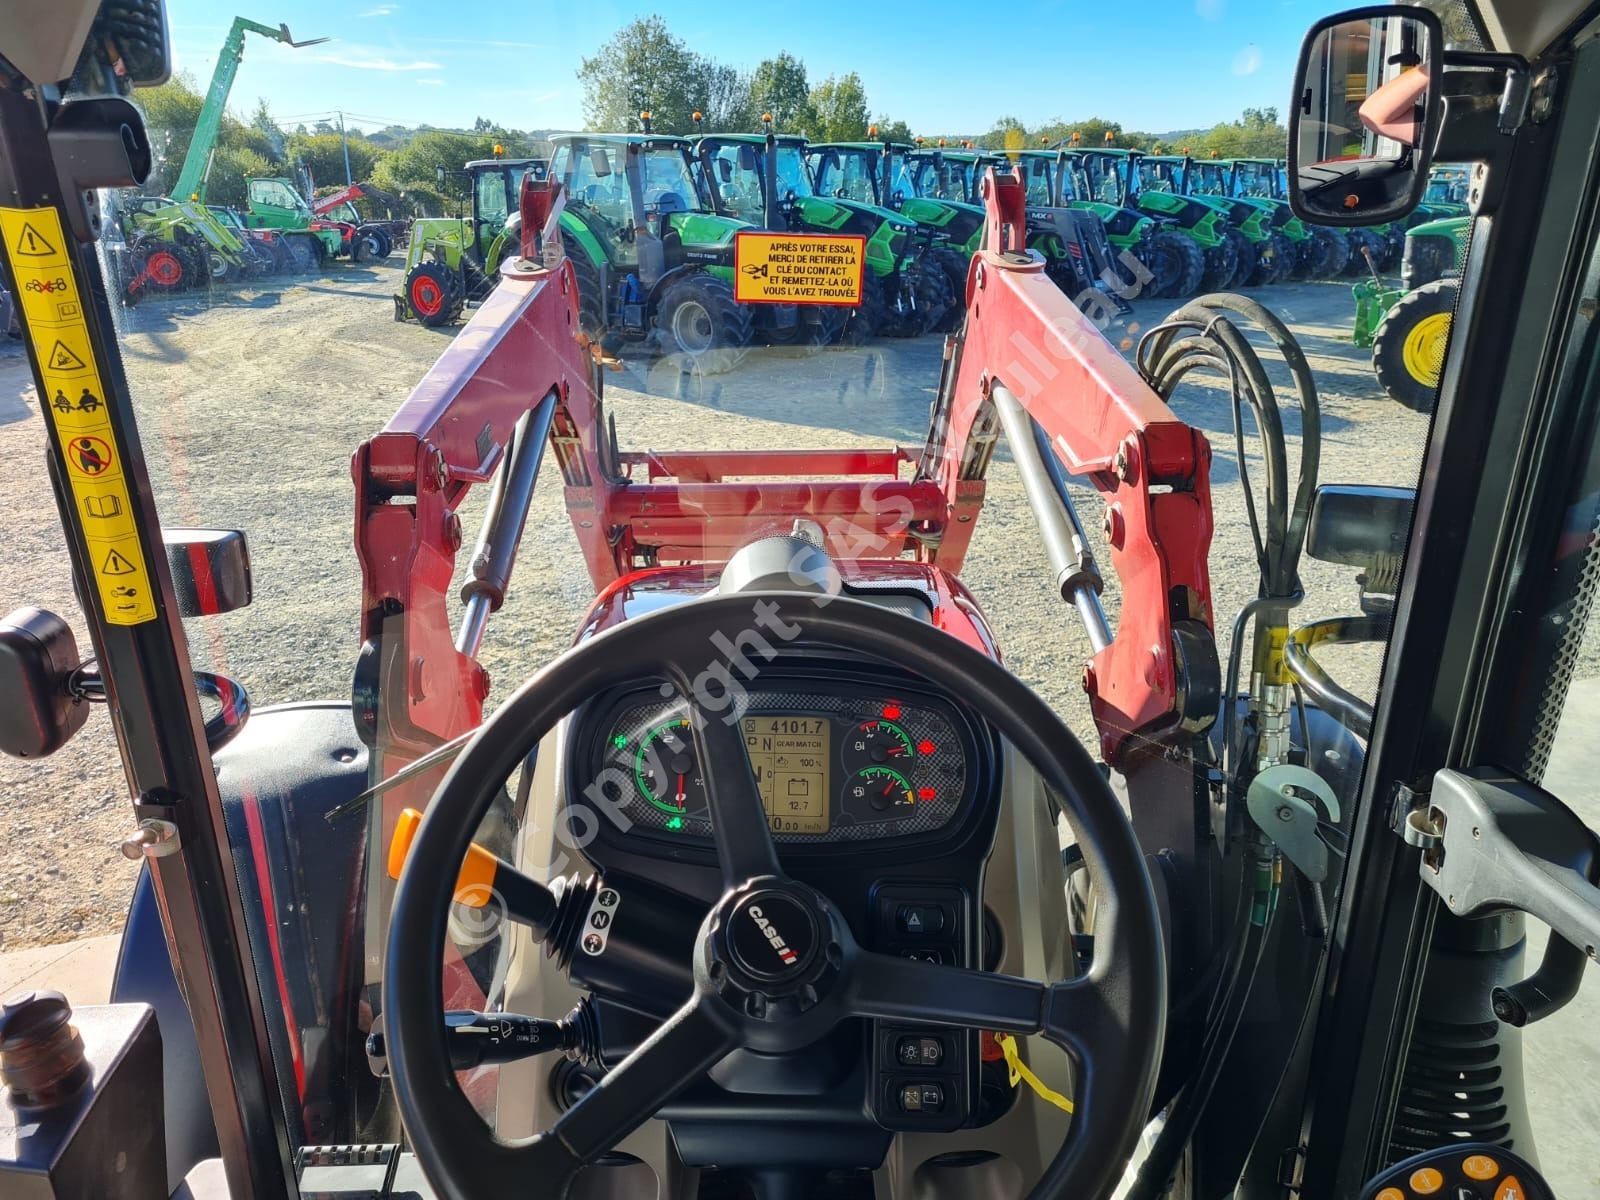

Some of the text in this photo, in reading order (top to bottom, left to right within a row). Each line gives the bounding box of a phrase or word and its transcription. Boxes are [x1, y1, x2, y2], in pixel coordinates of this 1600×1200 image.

[770, 242, 856, 255] APRÈS VOTRE ESSAI,
[768, 254, 856, 265] MERCI DE RETIRER LA
[776, 264, 847, 275] CLÉ DU CONTACT
[769, 276, 853, 287] ET REMETTEZ-LA OÙ
[763, 287, 858, 297] VOUS L'AVEZ TROUVÉE.
[771, 720, 823, 734] 4101.7
[763, 737, 772, 751] N
[800, 759, 814, 767] 100
[789, 801, 809, 810] 12.7
[594, 914, 607, 928] N
[748, 905, 787, 950] CASE
